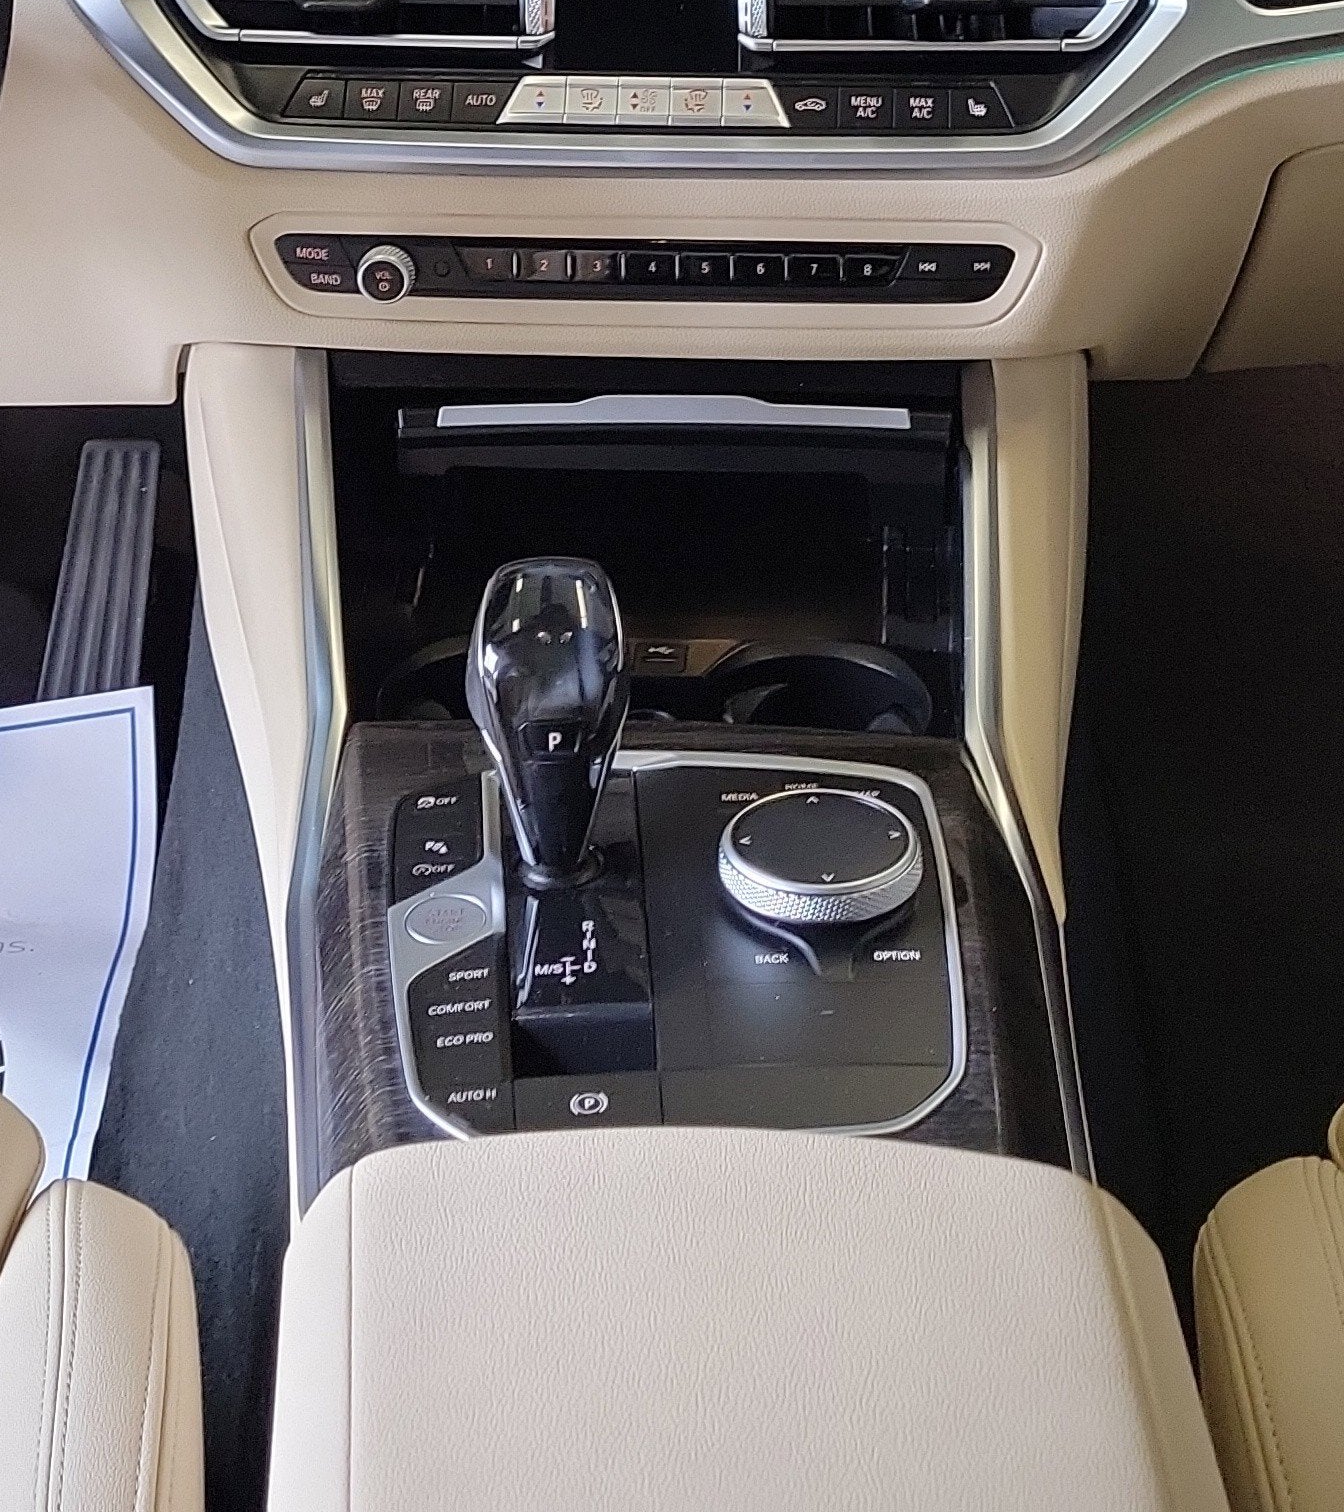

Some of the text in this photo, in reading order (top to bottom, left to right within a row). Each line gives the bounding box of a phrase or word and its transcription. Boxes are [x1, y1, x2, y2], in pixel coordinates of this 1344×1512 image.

[361, 88, 385, 98] MAX
[412, 88, 441, 100] REAR
[465, 94, 497, 106] AUTO
[850, 96, 883, 107] MENU
[909, 97, 935, 107] MAX
[856, 107, 878, 118] A/C
[911, 107, 933, 119] A/C
[295, 246, 330, 260] MODE
[485, 258, 493, 270] 1
[539, 259, 549, 271] 2
[592, 259, 602, 272] 3
[647, 261, 657, 273] 4
[701, 262, 710, 273] 5
[756, 262, 765, 275] 6
[809, 263, 819, 275] 7
[863, 263, 873, 276] 8
[310, 273, 342, 286] BAND
[548, 731, 563, 753] P
[721, 792, 759, 801] MEDIA
[754, 952, 790, 964] BACK
[873, 949, 921, 962] OPTION
[447, 967, 490, 982] SPORT
[427, 999, 492, 1017] COMFORT
[436, 1036, 464, 1048] ECO
[447, 1089, 485, 1104] AUTO
